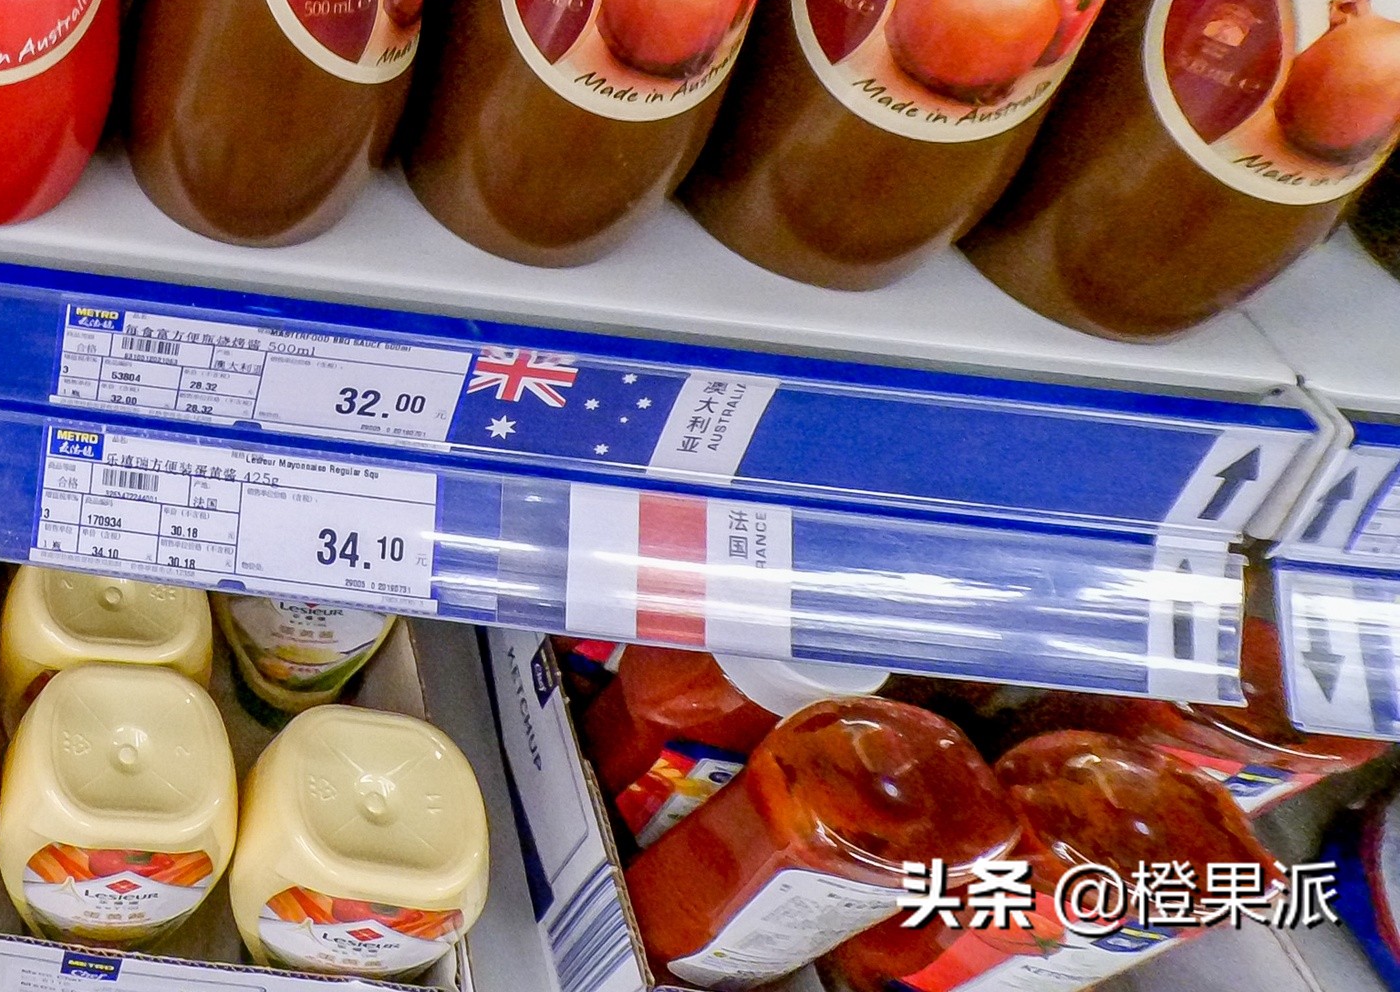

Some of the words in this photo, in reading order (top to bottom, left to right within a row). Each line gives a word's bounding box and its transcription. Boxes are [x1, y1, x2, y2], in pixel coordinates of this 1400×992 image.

[304, 0, 331, 16] 500
[574, 71, 640, 103] Made
[645, 88, 664, 103] in
[853, 78, 918, 118] Made
[925, 110, 948, 125] in
[268, 342, 316, 357] 500ml
[190, 381, 217, 391] 28.32
[111, 395, 137, 405] 32.00
[335, 387, 426, 418] 32.00
[186, 404, 213, 414] 28.32
[677, 381, 728, 453] 澳大利亚
[57, 430, 98, 444] METRO
[58, 476, 78, 488] 合格
[244, 471, 279, 488] 425g
[88, 514, 122, 528] 170934
[171, 525, 198, 538] 30.18
[729, 510, 749, 559] 法国
[92, 546, 119, 558] 34.10
[317, 528, 404, 569] 34.10
[168, 556, 196, 569] 30.18
